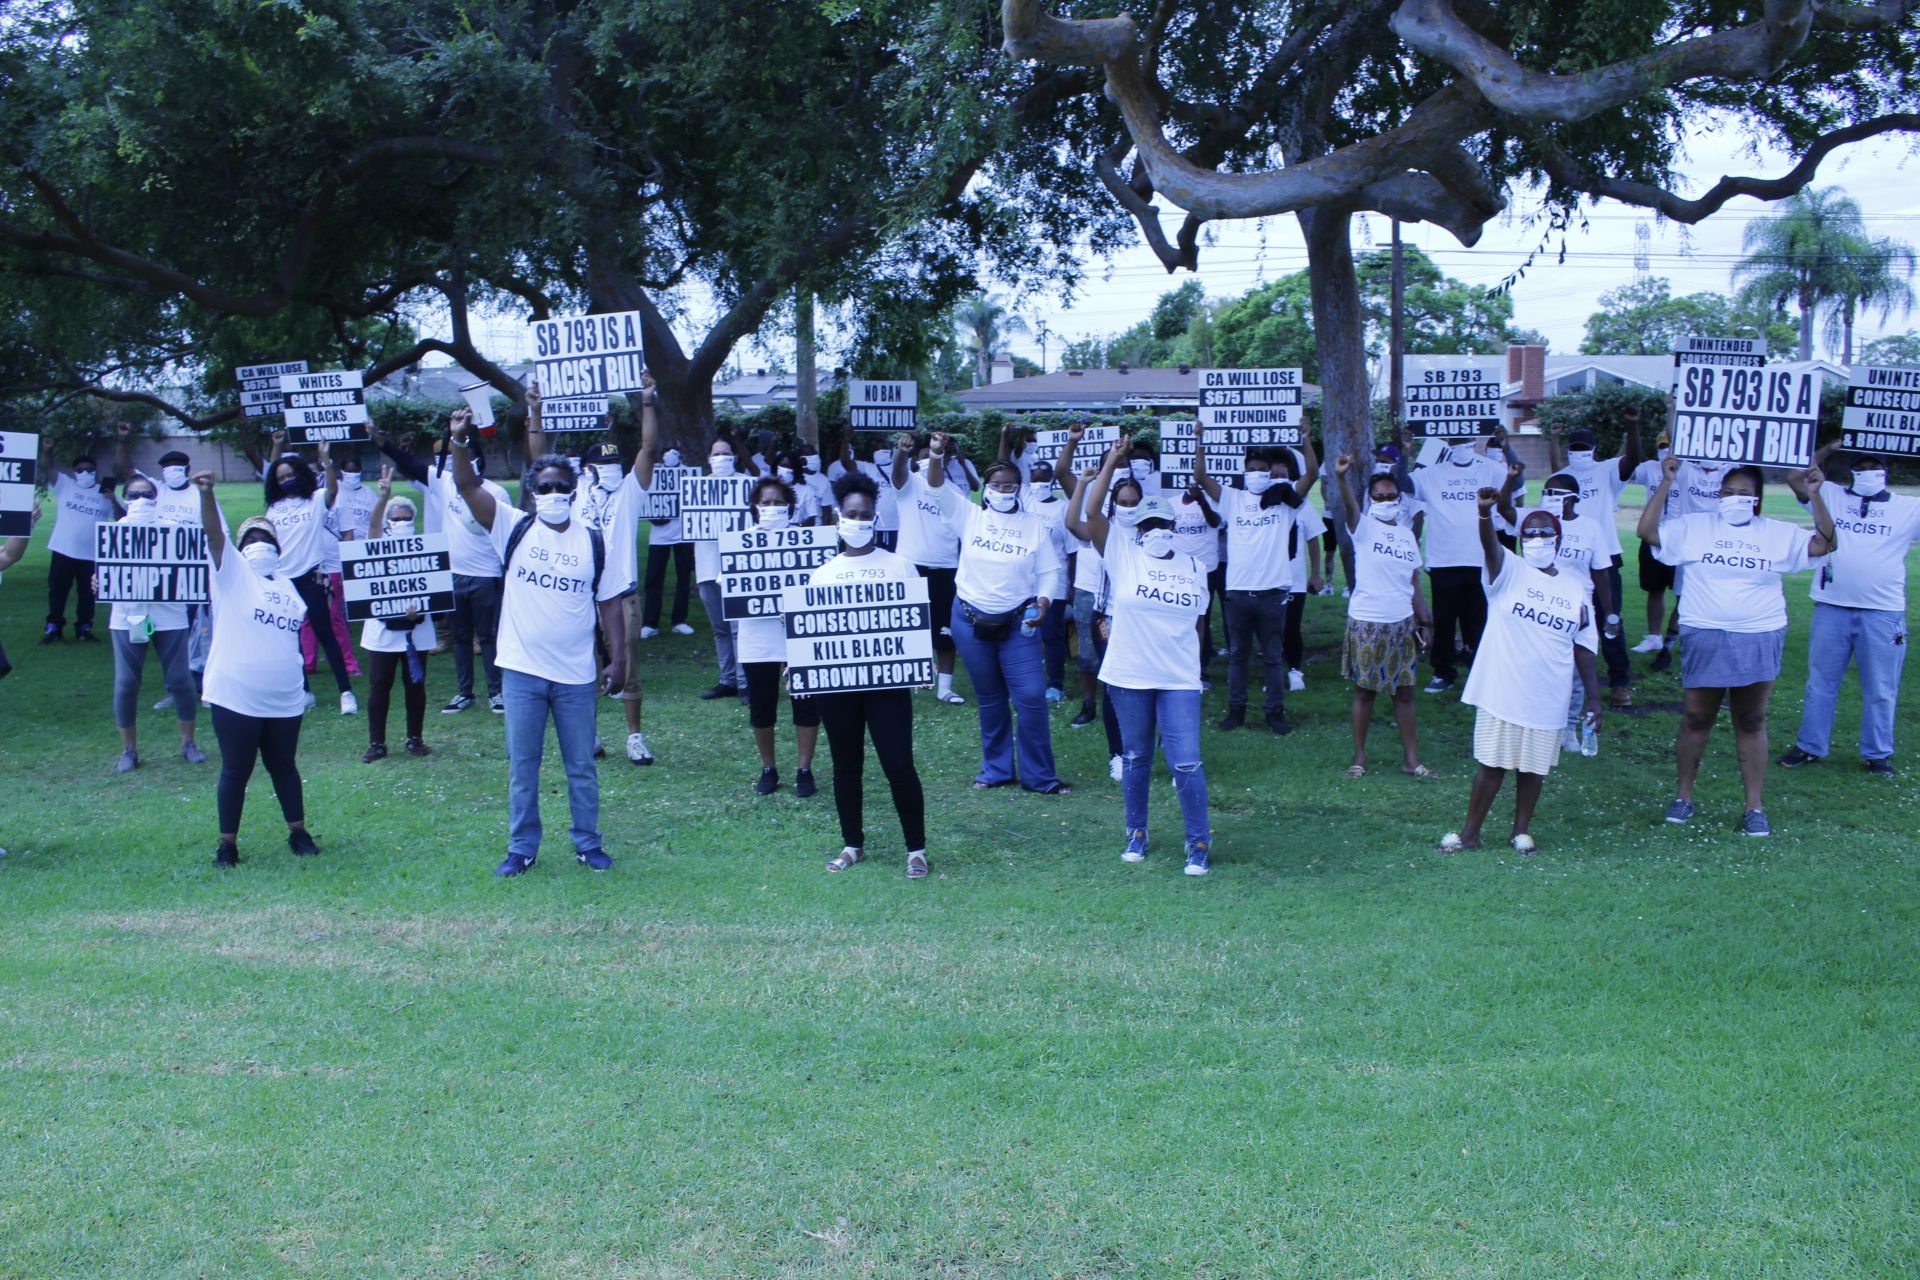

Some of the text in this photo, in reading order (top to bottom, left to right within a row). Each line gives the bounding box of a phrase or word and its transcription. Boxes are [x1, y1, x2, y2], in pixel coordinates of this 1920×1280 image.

[537, 315, 636, 356] SB 793 IS A
[1690, 338, 1752, 352] UNINTENDED
[242, 364, 302, 378] CA WILL LOSE
[536, 354, 642, 398] RACIST BILL
[1206, 372, 1295, 386] CA WILL LOSE
[1424, 370, 1482, 383] SB 793
[299, 374, 342, 388] WHITES
[290, 393, 314, 408] CAN
[316, 391, 356, 406] SMOKE
[865, 385, 902, 402] NO BAN
[1205, 390, 1296, 406] $675 MILLION
[1407, 385, 1500, 400] PROMOTES
[1684, 367, 1812, 414] SB 793 IS A
[245, 406, 264, 416] DUE
[265, 405, 278, 414] TO
[304, 410, 347, 423] BLACKS
[851, 409, 914, 427] ON MENTHOL
[1214, 409, 1286, 423] IN FUNDING
[1410, 404, 1496, 417] PROBABLE
[557, 417, 597, 428] NOT??
[1425, 421, 1480, 435] CAUSE
[1866, 412, 1894, 429] KILL
[305, 426, 350, 441] CANNOT
[1052, 429, 1104, 443] HOAH
[1202, 429, 1299, 444] DUE TO SB 793
[1674, 414, 1810, 465] RACIST BILL
[1843, 433, 1852, 446] &
[1856, 432, 1910, 452] BROWN
[1040, 448, 1052, 459] IS
[1162, 440, 1176, 454] IS
[654, 469, 674, 490] 793
[1173, 475, 1186, 488] IS
[682, 480, 738, 506] EXEMPT
[1442, 492, 1477, 500] RACIS
[640, 494, 678, 517] ACIST
[683, 511, 739, 540] EXEMPT
[1236, 514, 1280, 527] RACIST!
[1834, 518, 1892, 536] RACIST!
[98, 526, 208, 560] EXEMPT ONE
[366, 538, 424, 556] WHITES
[742, 530, 814, 548] SB 793
[972, 536, 1028, 558] RACIST!
[529, 547, 579, 566] SB 793
[722, 548, 836, 572] PROMOTES
[1702, 552, 1772, 572] RACIST!
[353, 556, 440, 578] CAN SMOKE
[860, 568, 886, 578] 793
[1148, 570, 1167, 582] SB
[98, 566, 206, 600] EXEMPT ALL
[370, 577, 428, 596] BLACKS
[516, 567, 586, 592] RACIST!
[806, 582, 906, 606] UNINTENDED
[1527, 587, 1544, 602] SB
[370, 596, 430, 616] CANNOT
[254, 608, 303, 632] RACIS
[793, 606, 922, 635] CONSEQUENCES
[1512, 602, 1579, 635] RACIST!
[814, 636, 905, 661] KILL BLACK
[792, 661, 931, 690] & BROWN PEOPLE
